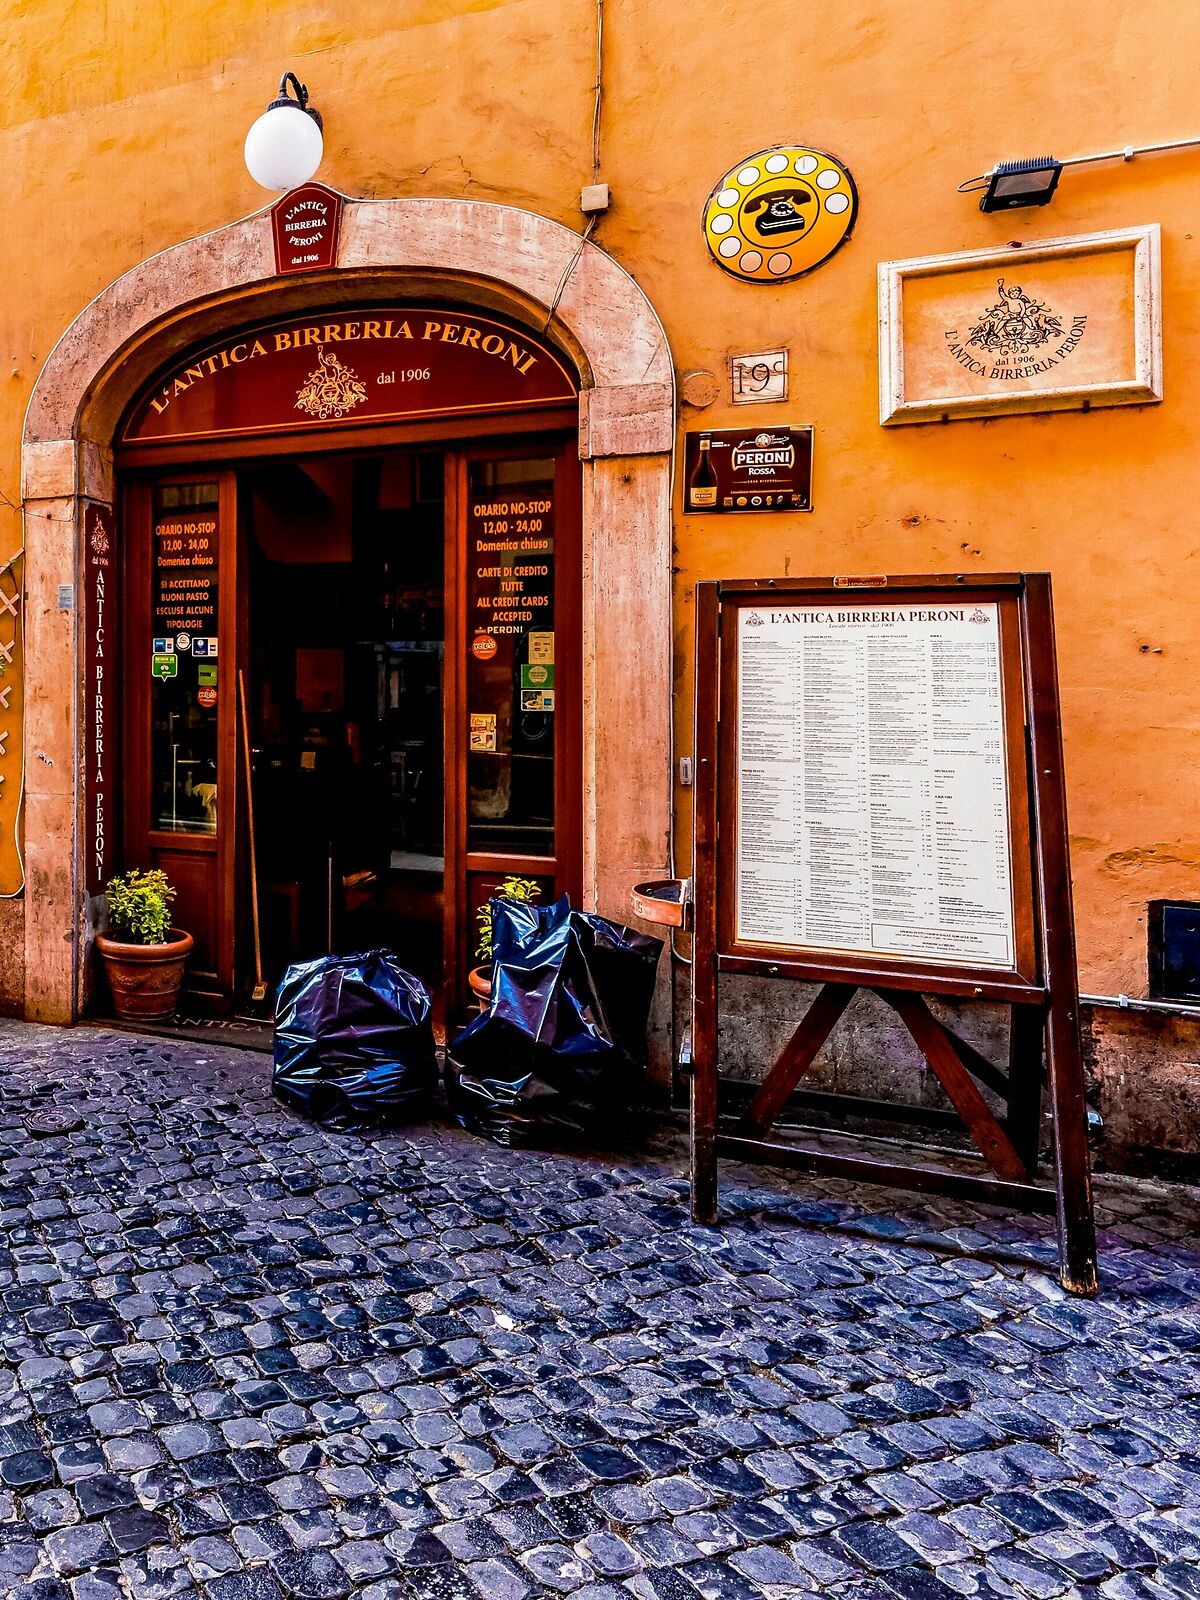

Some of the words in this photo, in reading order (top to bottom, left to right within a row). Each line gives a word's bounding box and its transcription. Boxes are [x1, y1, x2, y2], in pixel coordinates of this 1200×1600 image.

[285, 201, 327, 220] L'ANTICA
[285, 218, 327, 232] BIRRERIA
[289, 232, 323, 246] PERONI
[291, 256, 302, 264] dal
[303, 254, 319, 263] 1906
[989, 357, 1059, 380] BIRRERIA
[1055, 315, 1088, 359] PERONI
[149, 340, 268, 415] L'ANTICA
[274, 320, 414, 352] BIRRERIA
[421, 321, 539, 375] PERONI
[995, 358, 1009, 366] dal
[1013, 356, 1035, 365] 1906
[376, 371, 396, 384] dal
[400, 367, 431, 382] 1906
[737, 452, 790, 465] PERONI
[474, 503, 508, 517] ORARIO
[511, 501, 552, 515] NO-STOP
[155, 524, 183, 535] ORARIO
[184, 522, 216, 534] NO-STOP
[483, 521, 508, 535] 12,00
[516, 519, 542, 533] 24,00
[163, 540, 182, 551] 12,00
[188, 539, 209, 551] 24,00
[476, 538, 518, 552] Domenica
[520, 537, 548, 550] chiuso
[157, 555, 190, 566] Domenica
[191, 554, 214, 565] chiuso
[477, 568, 501, 578] CARTE
[503, 567, 512, 577] DI
[514, 566, 548, 576] CREDITO
[169, 579, 210, 588] ACCETTANO
[501, 582, 524, 591] TUTTE
[161, 593, 185, 601] BUONI
[186, 592, 209, 601] PASTO
[477, 597, 491, 607] ALL
[492, 597, 519, 607] CREDIT
[521, 596, 549, 606] CARDS
[95, 570, 105, 657] ANTICA
[156, 606, 184, 615] ESCLUSE
[186, 605, 214, 614] ALCUNE
[492, 612, 532, 621] ACCEPTED
[770, 612, 834, 624] L'ANTICA
[837, 611, 906, 623] BIRRERIA
[909, 610, 965, 622] PERONI
[166, 620, 203, 628] TIPOLOGIE
[486, 626, 523, 634] PERONI
[95, 665, 104, 783] BIRRERIA
[96, 792, 104, 881] PERONI
